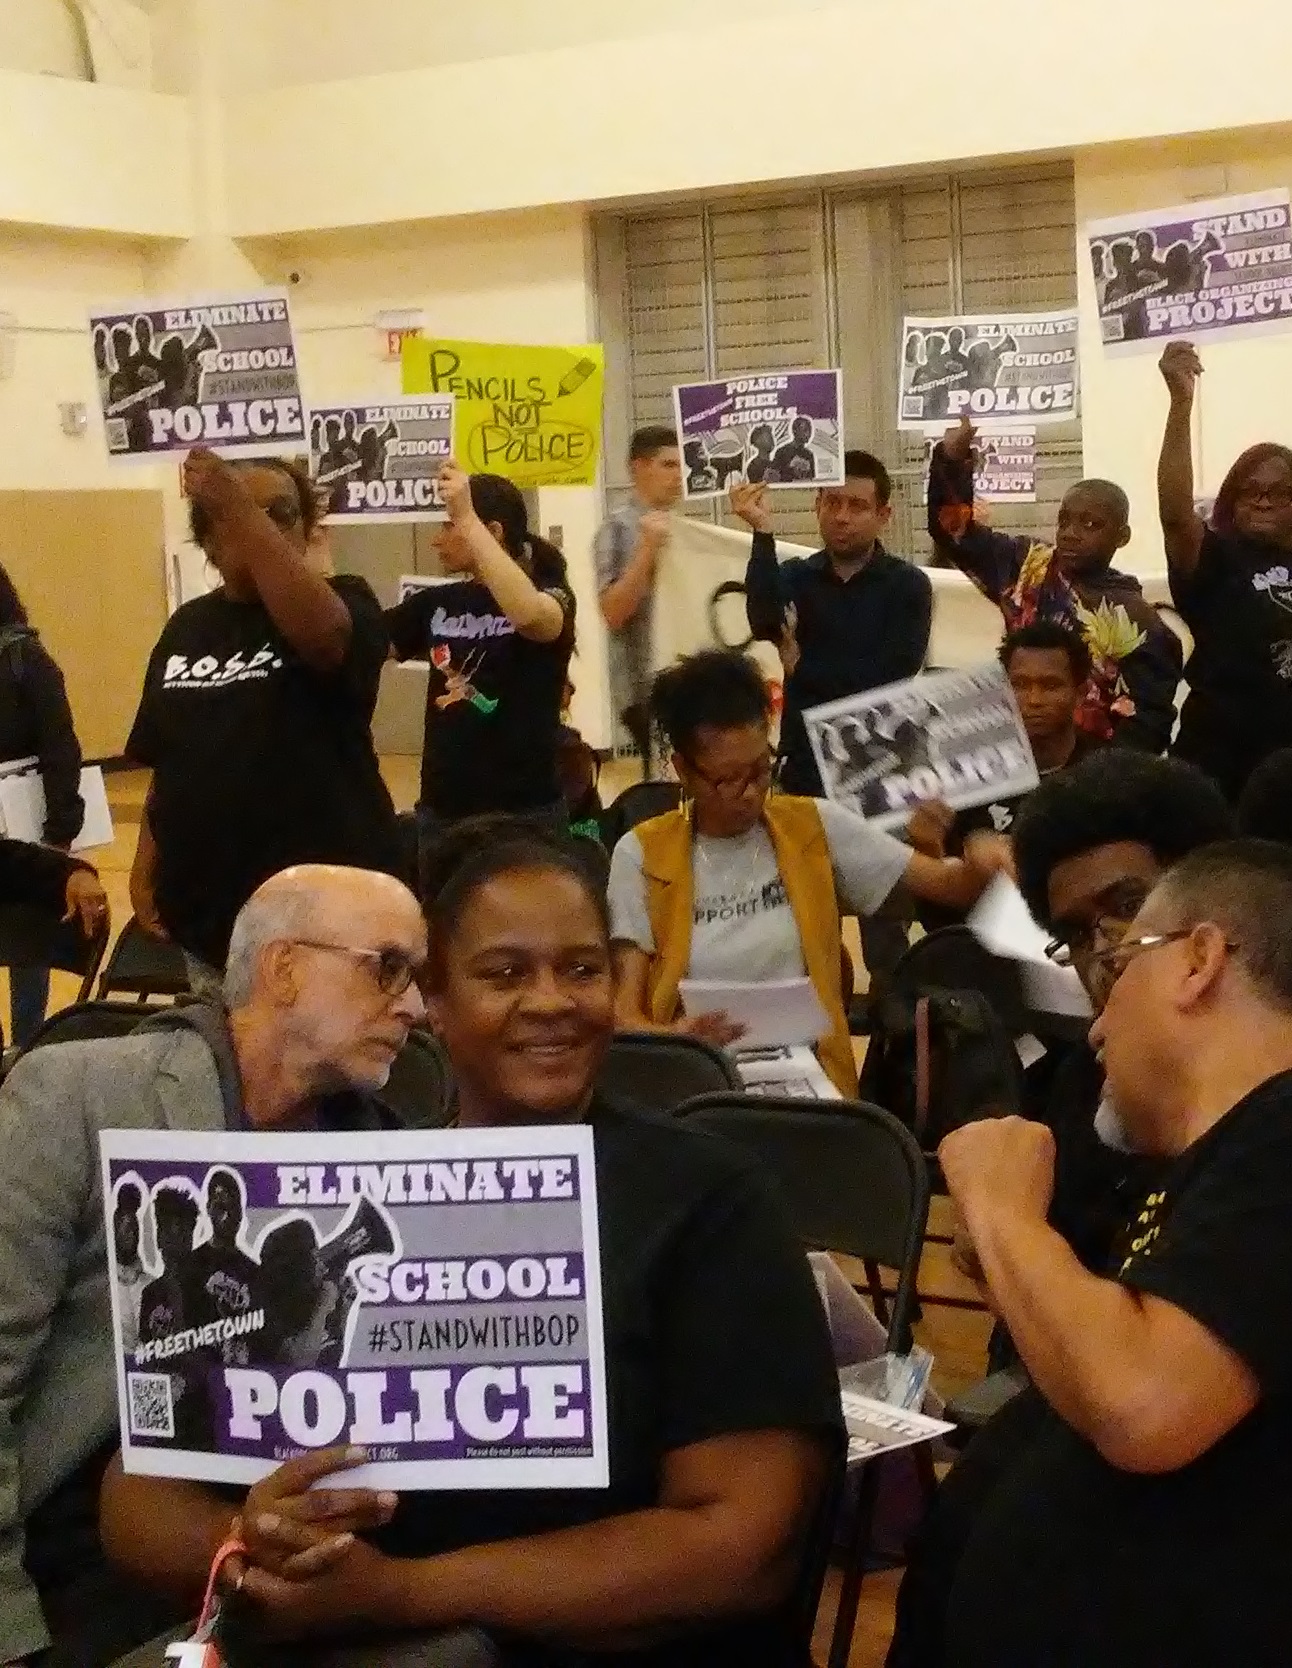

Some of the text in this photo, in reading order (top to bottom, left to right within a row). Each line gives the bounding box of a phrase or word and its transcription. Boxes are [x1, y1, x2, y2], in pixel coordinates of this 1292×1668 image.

[1192, 207, 1287, 240] STAND
[1224, 243, 1292, 268] WITH
[1145, 291, 1196, 308] BLACK
[164, 301, 286, 330] ELIMINATE
[977, 318, 1077, 338] ELIMINATE
[201, 347, 294, 373] SCHOOL
[1001, 350, 1076, 367] SCHOOL
[726, 377, 788, 395] POLICE
[947, 383, 1073, 414] POLICE
[365, 405, 450, 422] ELIMINATE
[493, 401, 553, 427] NOT
[735, 393, 778, 410] FREE
[149, 398, 301, 444] POLICE
[720, 407, 798, 427] SCHOOLS
[387, 440, 449, 456] SCHOOL
[481, 424, 586, 466] POLICE
[981, 436, 1034, 447] STAND
[998, 455, 1034, 464] WITH
[975, 479, 1034, 490] OJECT
[277, 1158, 573, 1205] ELIMINATE
[357, 1257, 580, 1302] SCHOOL
[134, 1308, 265, 1366] #FREETHETOWN
[368, 1314, 580, 1353] #STANDWITHBOP
[224, 1364, 585, 1448] POLICE
